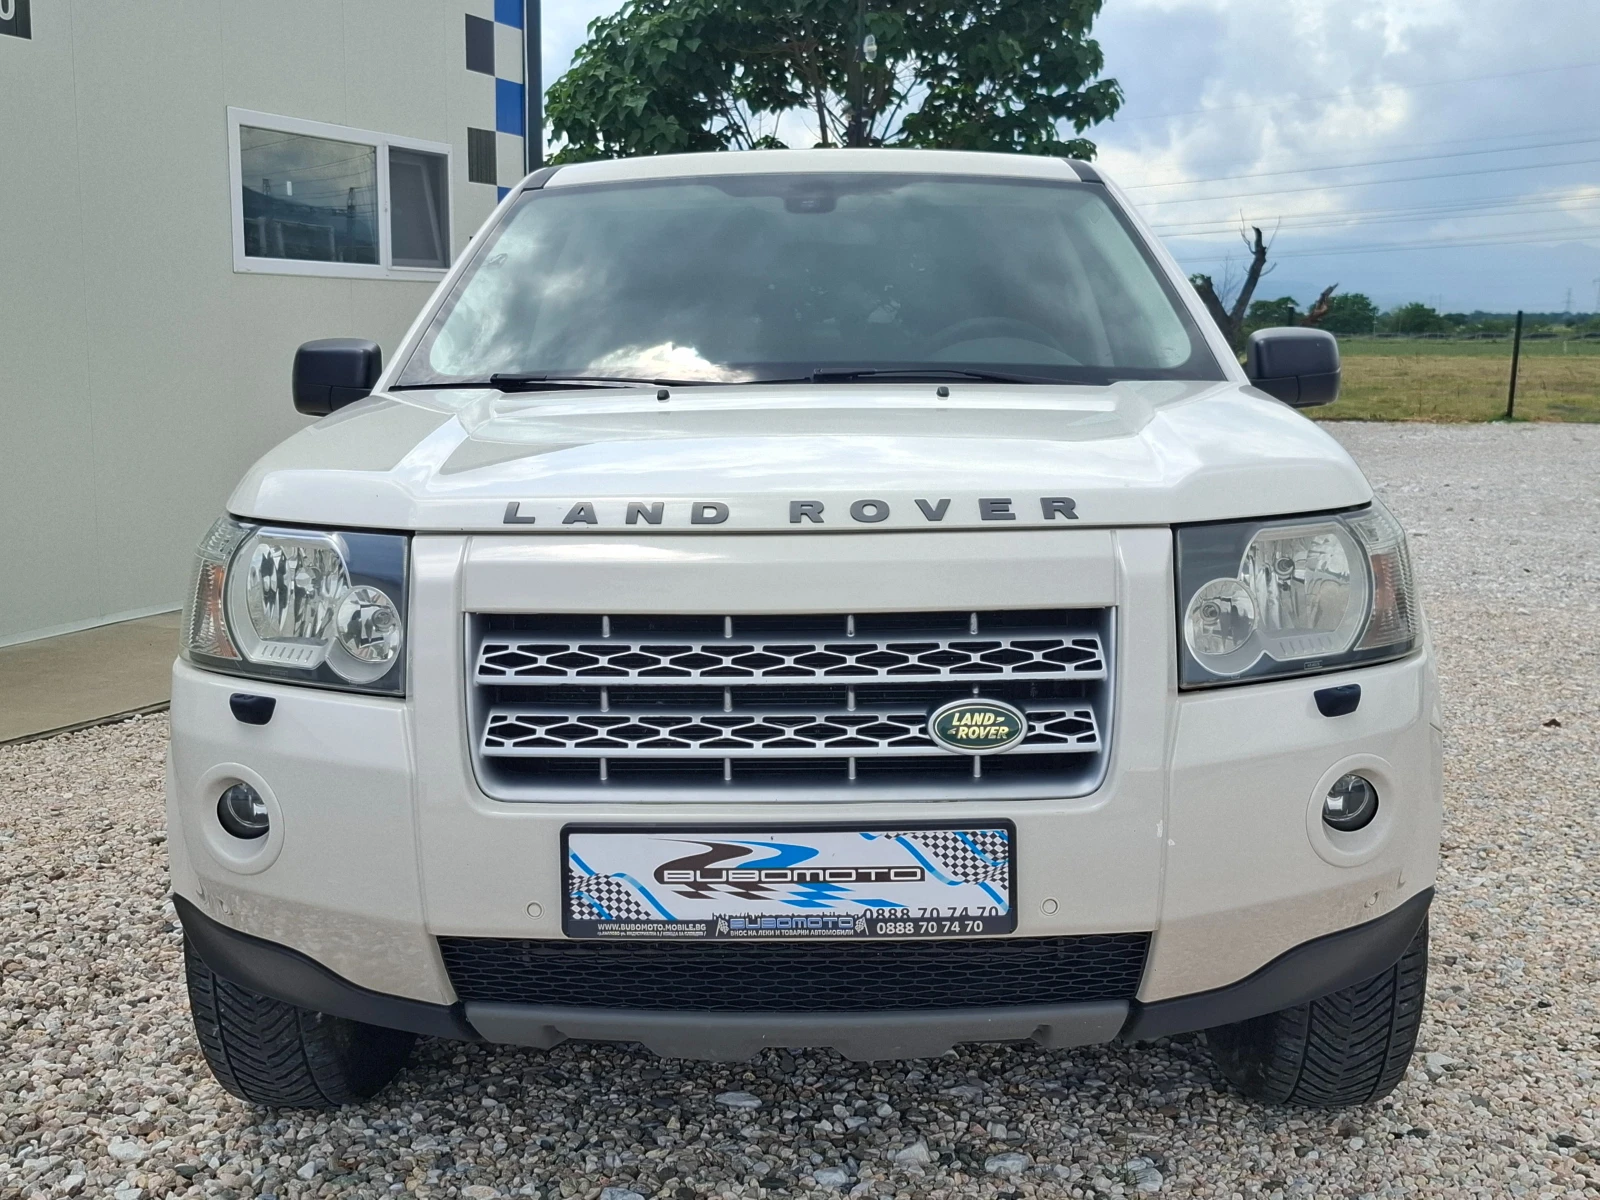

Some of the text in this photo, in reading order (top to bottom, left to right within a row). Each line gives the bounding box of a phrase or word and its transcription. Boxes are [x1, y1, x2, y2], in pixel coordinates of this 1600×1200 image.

[503, 496, 1079, 524] LAND ROVER
[951, 712, 995, 726] LAND
[957, 726, 1009, 739] ROVER
[663, 868, 921, 882] BUBOMOTO
[597, 923, 707, 931] WWW.BUBOMOTO.MOBILE.BG
[877, 920, 984, 934] 0888 70 74 70
